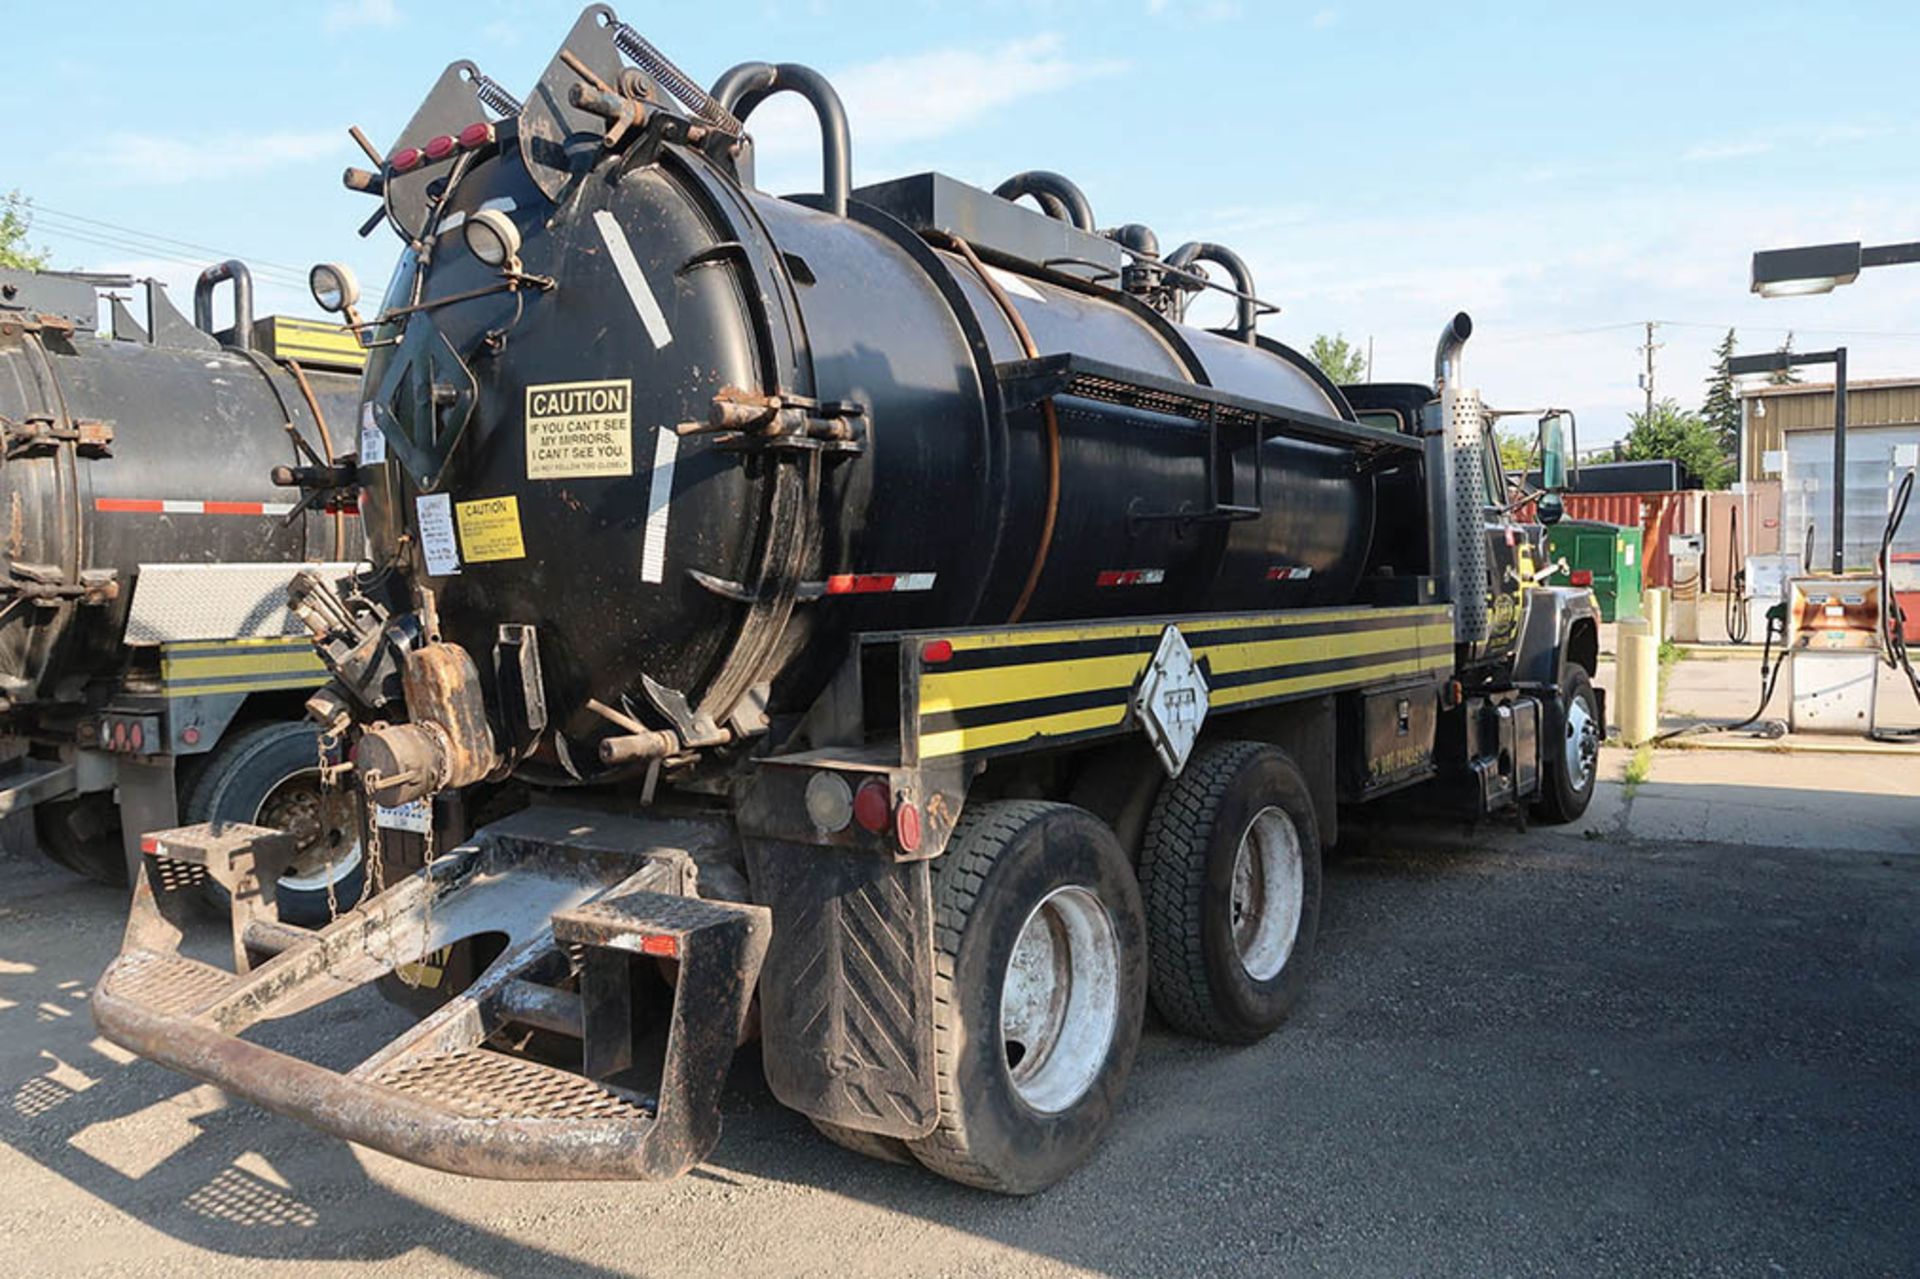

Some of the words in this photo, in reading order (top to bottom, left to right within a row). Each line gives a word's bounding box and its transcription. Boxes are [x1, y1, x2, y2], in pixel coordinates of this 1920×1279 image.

[534, 389, 622, 415] CAUTION
[530, 424, 538, 434] IF
[541, 422, 563, 433] YOU
[567, 420, 599, 432] CAN'T
[604, 419, 626, 430] SEE
[541, 436, 555, 446] MY
[538, 448, 569, 460] CAN'T
[572, 447, 594, 458] SEE
[465, 500, 507, 516] CAUTION
